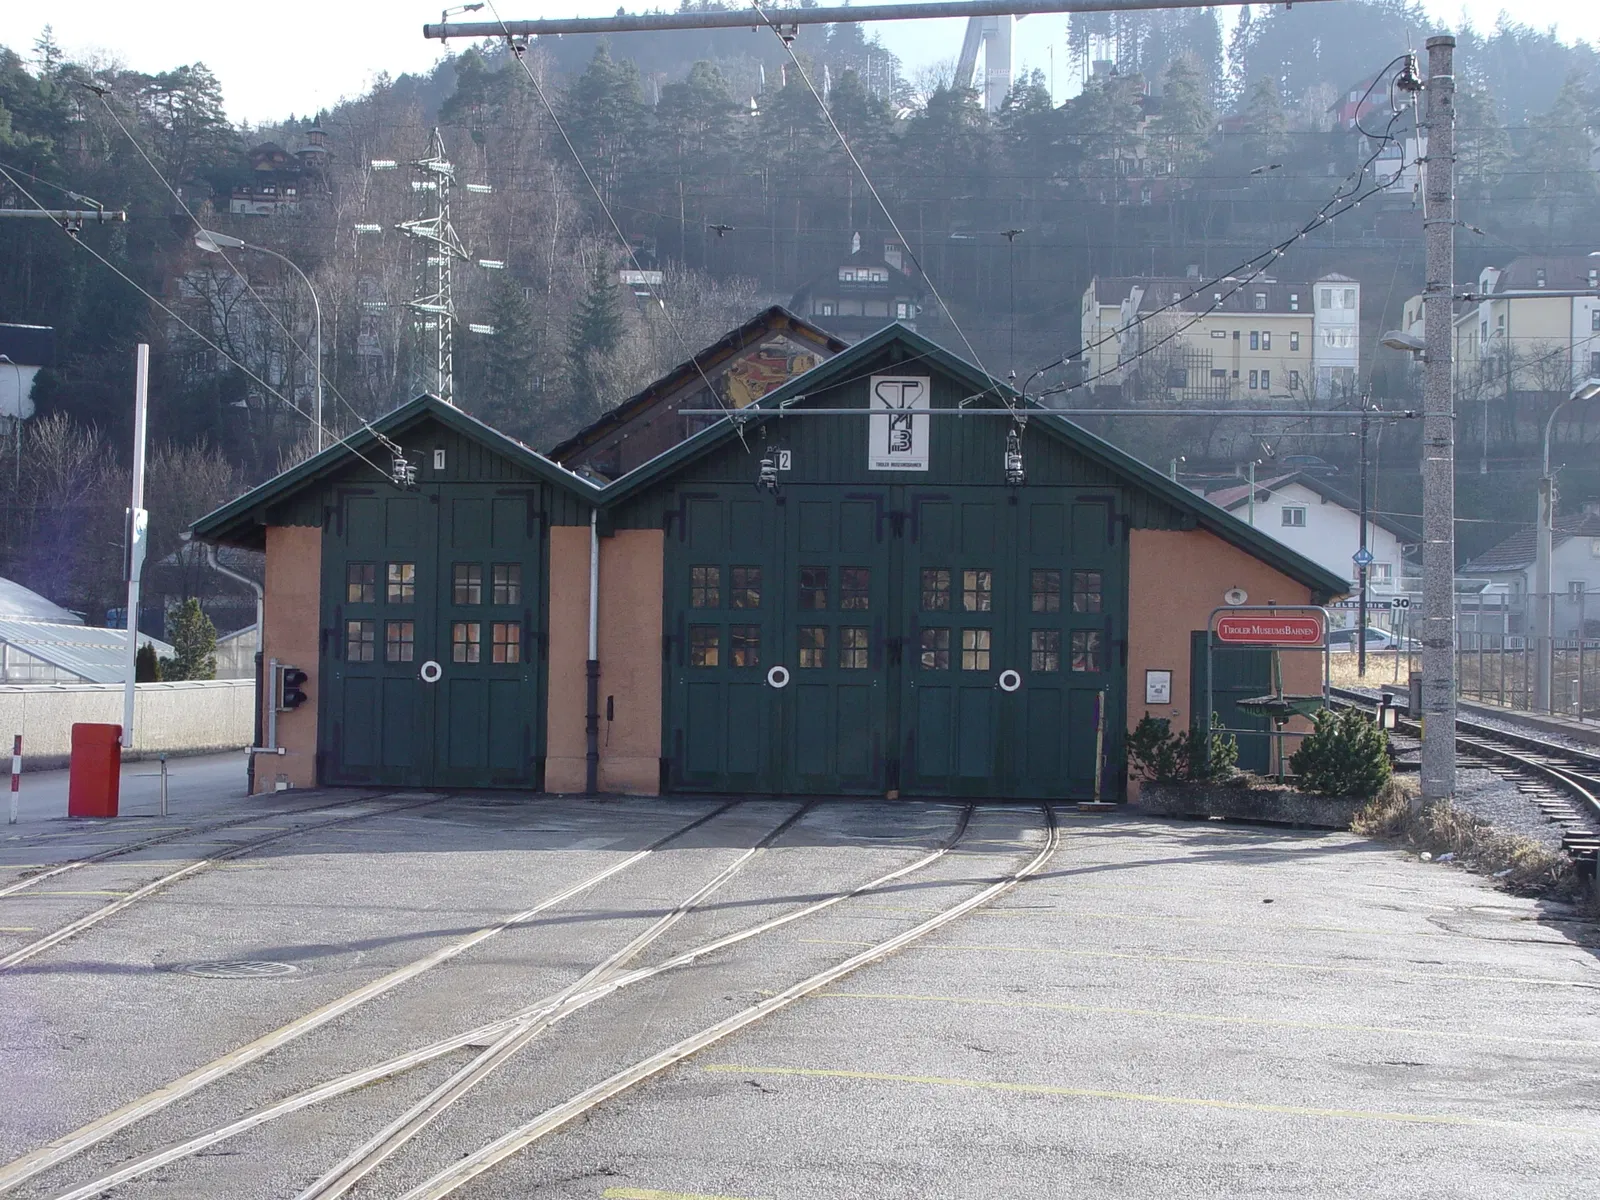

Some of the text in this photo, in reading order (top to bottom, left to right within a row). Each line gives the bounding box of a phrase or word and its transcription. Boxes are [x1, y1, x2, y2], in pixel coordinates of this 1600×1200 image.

[436, 451, 443, 468] 1
[781, 452, 789, 469] 2
[1392, 598, 1410, 608] 30
[1223, 624, 1251, 634] TIROLER
